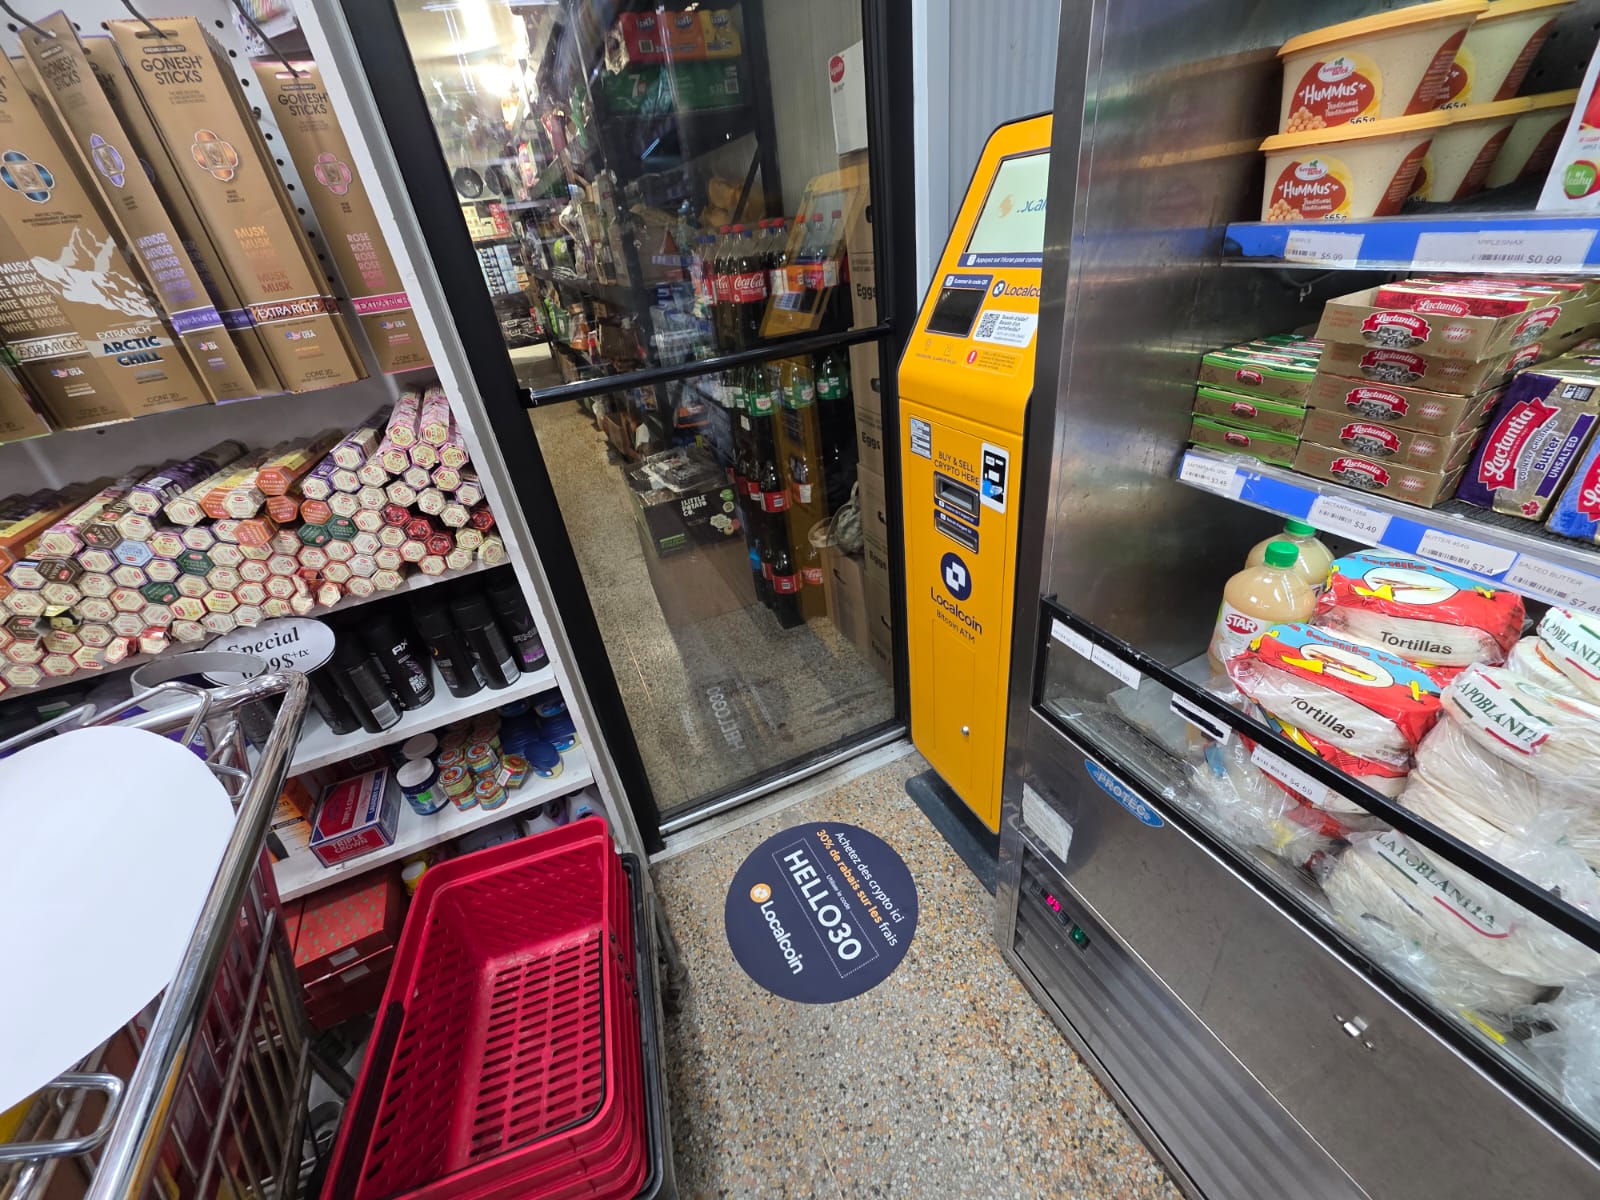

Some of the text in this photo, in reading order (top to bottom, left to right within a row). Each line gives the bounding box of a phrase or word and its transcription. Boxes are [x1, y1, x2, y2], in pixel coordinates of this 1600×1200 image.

[141, 56, 202, 72] GONESH
[154, 70, 202, 85] STICKS
[278, 93, 328, 104] GONESH
[290, 104, 328, 116] STICKS
[234, 226, 267, 239] MUSK
[346, 232, 370, 243] ROSE
[350, 242, 373, 251] ROSE
[1527, 254, 1562, 264] $0.99
[0, 260, 34, 274] MUSK
[7, 272, 41, 285] MUSK
[15, 284, 50, 297] MUSK
[262, 282, 293, 294] MUSK
[23, 295, 57, 308] MUSK
[1417, 300, 1463, 314] Lactantia
[30, 306, 64, 320] MUSK
[257, 302, 319, 320] EXTRA RICH
[1, 320, 35, 334] WHITE
[1375, 313, 1420, 328] Lactantia
[129, 325, 152, 336] RICH
[103, 335, 161, 354] ARCTIC
[117, 352, 164, 367] CHILL
[1373, 350, 1418, 364] Lactantia
[1358, 390, 1399, 404] Lactantia
[1352, 425, 1392, 441] Lactantia
[1484, 408, 1536, 482] Lactantia
[1534, 436, 1563, 472] Butter
[1548, 436, 1579, 478] UNSALTED
[938, 451, 975, 473] BUY & SELL
[1342, 459, 1381, 475] Lactantia
[934, 459, 980, 486] CRYPTO HERE
[1353, 520, 1377, 534] $3.49
[931, 586, 983, 635] Localcoin
[936, 609, 976, 645] Bitcoin ATM
[1226, 613, 1258, 633] STAR
[1381, 631, 1452, 655] Tortillas
[1291, 696, 1356, 740] Tortillas
[835, 831, 905, 924] Achetez des crypto ici
[816, 828, 898, 948] 30% de rabais sur les frais
[783, 849, 863, 961] HELLO30
[760, 900, 804, 976] Localcoin
